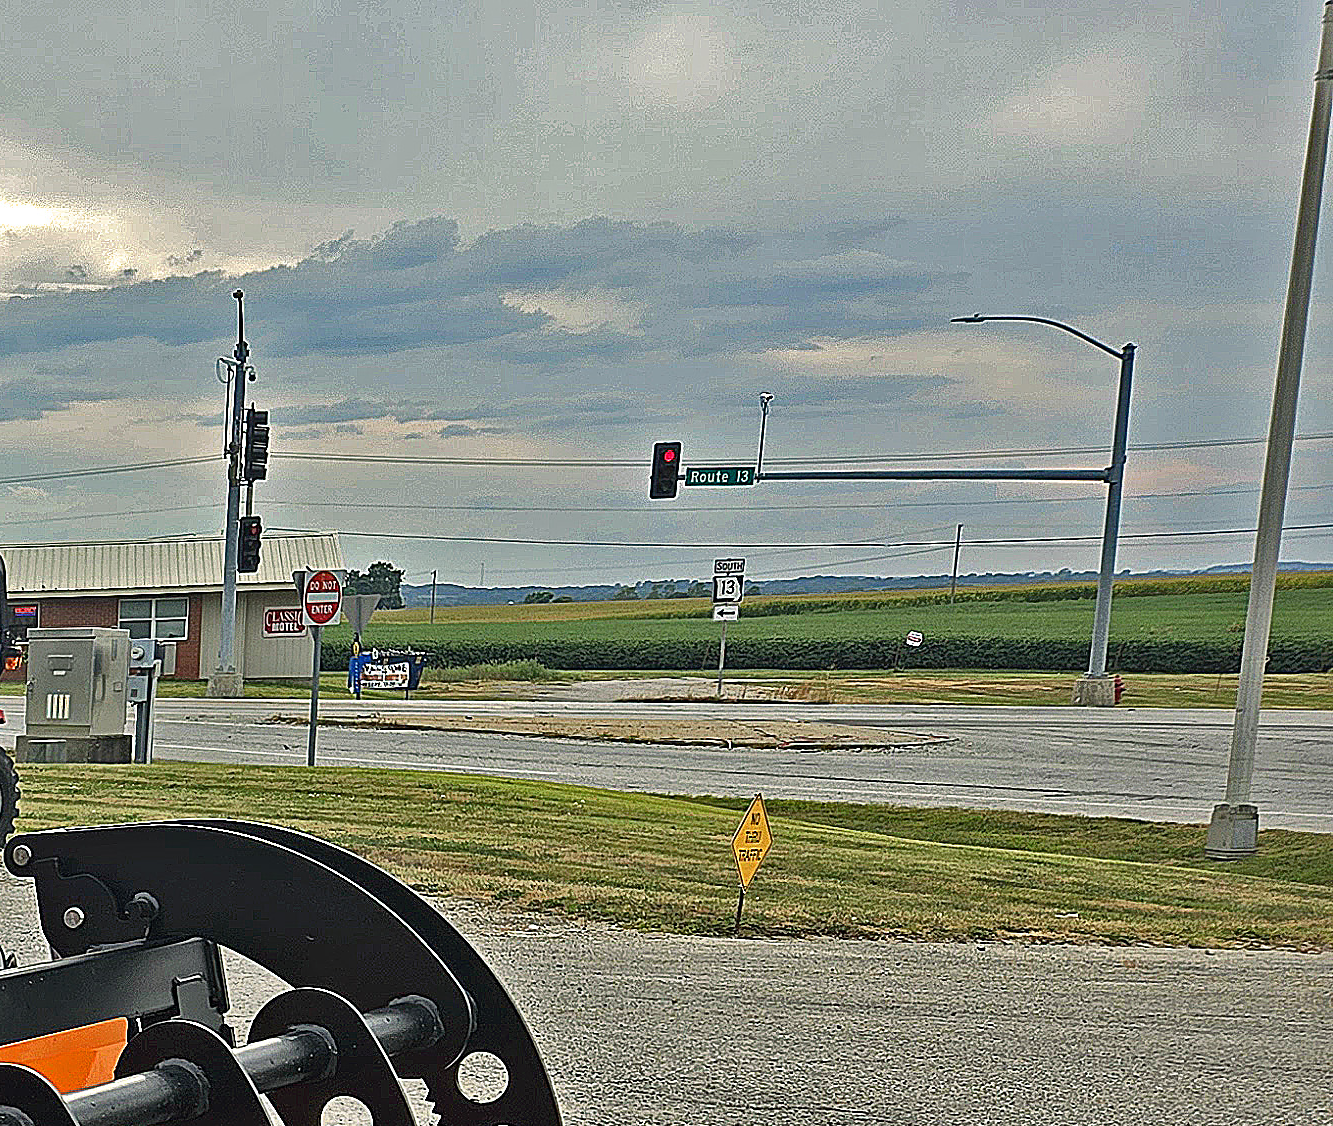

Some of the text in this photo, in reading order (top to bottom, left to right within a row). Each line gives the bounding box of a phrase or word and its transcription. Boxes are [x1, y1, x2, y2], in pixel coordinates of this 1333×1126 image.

[691, 470, 749, 483] Route 13
[716, 561, 743, 571] SOUTH
[309, 580, 337, 591] DO NOT
[721, 579, 736, 595] 13
[311, 604, 333, 615] ENTER
[271, 622, 300, 632] MOTEL
